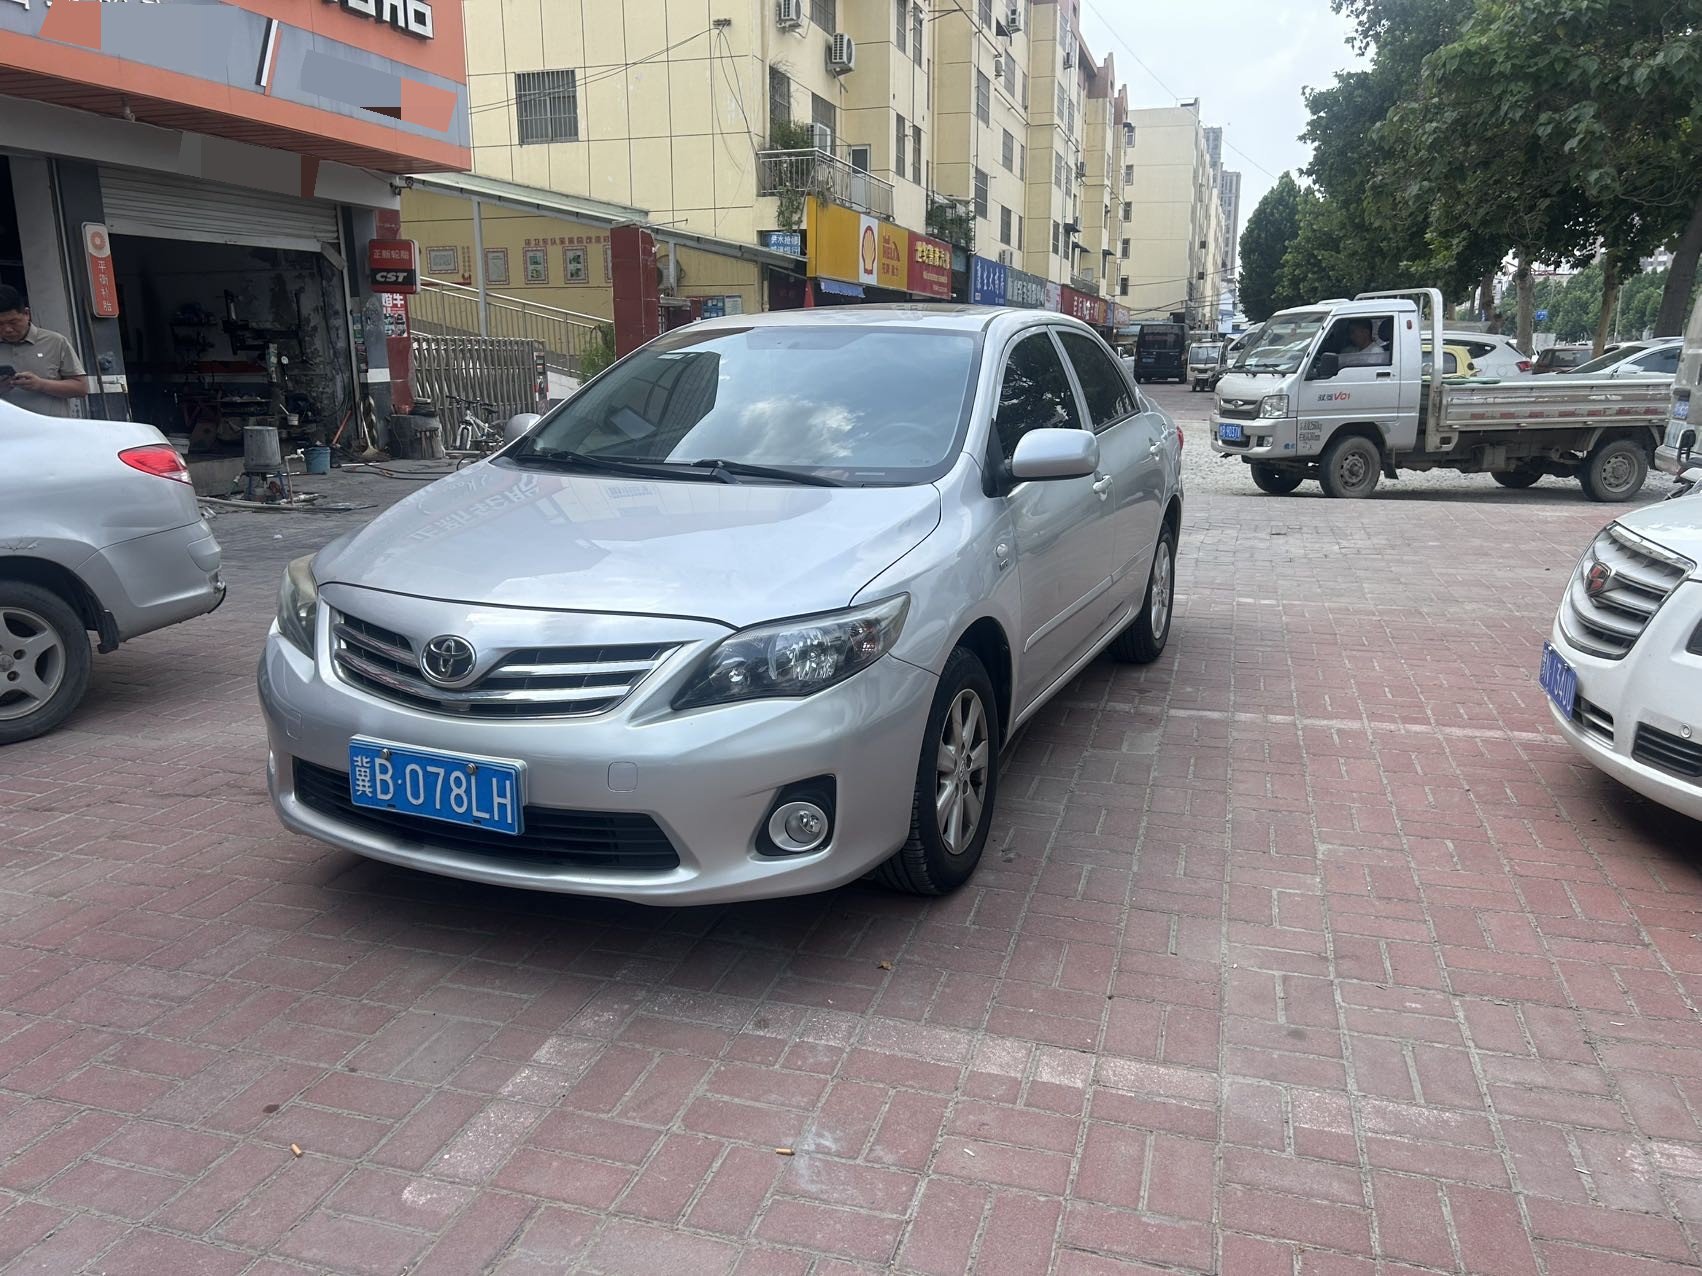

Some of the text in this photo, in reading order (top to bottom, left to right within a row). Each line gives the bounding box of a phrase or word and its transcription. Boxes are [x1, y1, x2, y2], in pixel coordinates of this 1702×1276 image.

[373, 249, 409, 260] 正新轮胎
[97, 260, 112, 311] 平衡补胎
[376, 272, 408, 283] CST
[353, 755, 512, 824] 冀B·078LH
